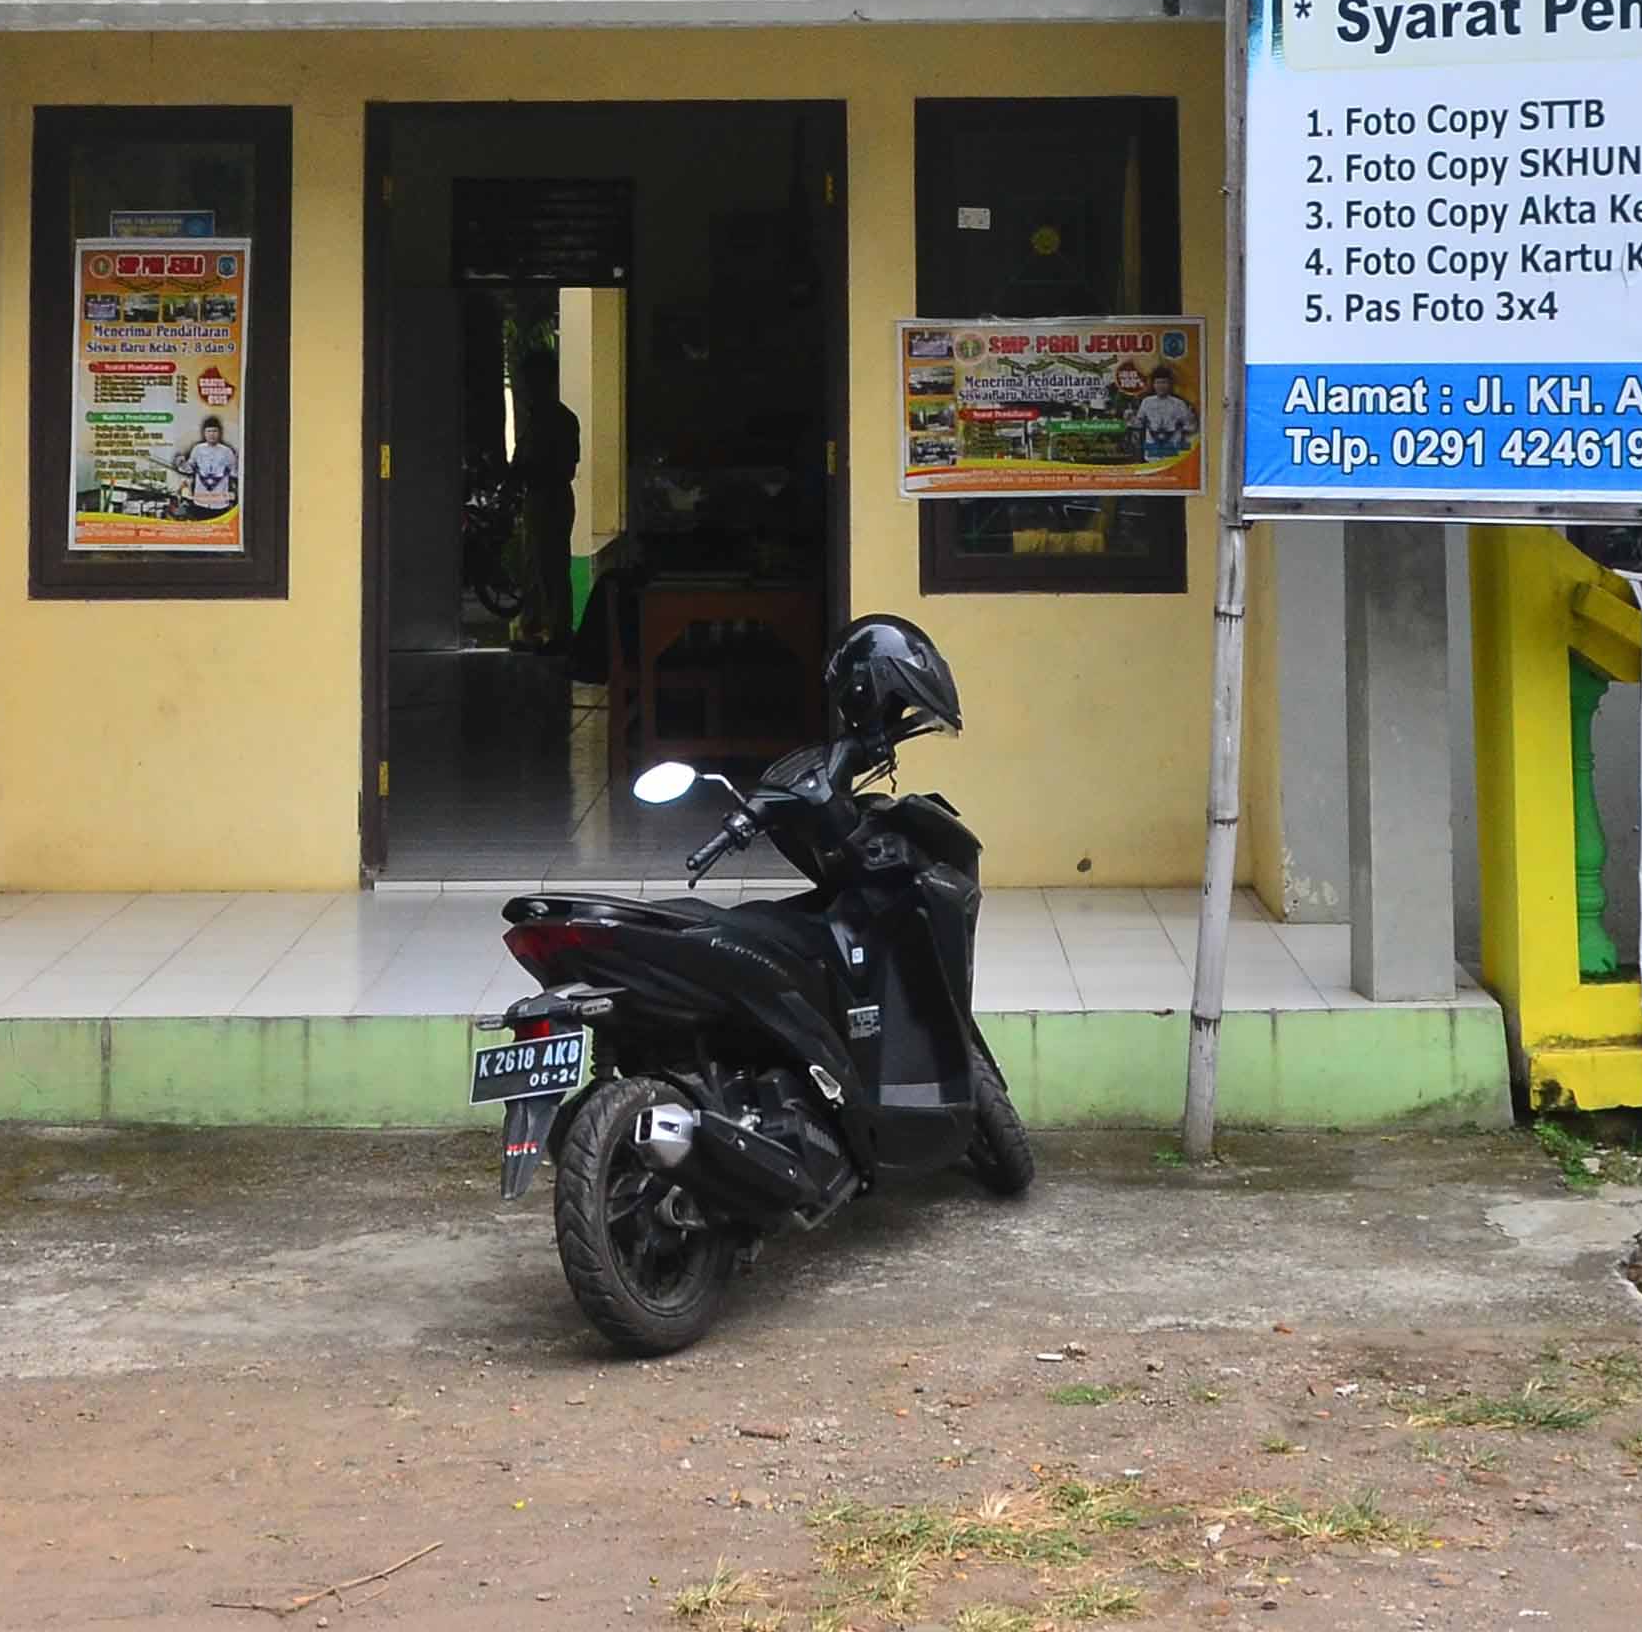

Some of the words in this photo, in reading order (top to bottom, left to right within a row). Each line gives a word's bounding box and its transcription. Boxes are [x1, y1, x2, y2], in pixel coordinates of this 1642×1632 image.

[1307, 109, 1333, 137] 1.
[1345, 107, 1416, 137] Foto
[1427, 104, 1509, 139] Copy
[1519, 99, 1605, 130] STTB
[1306, 155, 1333, 183] 2.
[1345, 154, 1416, 183] Foto
[1427, 151, 1509, 186] Copy
[1519, 145, 1642, 178] SKHUN
[1305, 201, 1333, 229] 3.
[1345, 200, 1416, 229] Foto
[1427, 198, 1509, 234] Copy
[1519, 194, 1597, 225] Akta
[1304, 248, 1333, 276] 4.
[1345, 247, 1416, 276] Foto
[1427, 245, 1509, 281] Copy
[1520, 243, 1613, 273] Kartu
[1305, 294, 1333, 322] 5.
[1345, 294, 1401, 322] Pas
[1413, 292, 1484, 322] Foto
[1496, 291, 1558, 321] 3x4
[1284, 376, 1429, 415] Alamat
[1464, 378, 1514, 416] Jl.
[1526, 377, 1603, 416] KH.
[1284, 428, 1378, 474] Telp.
[1391, 428, 1487, 467] 0291
[479, 1054, 492, 1078] K
